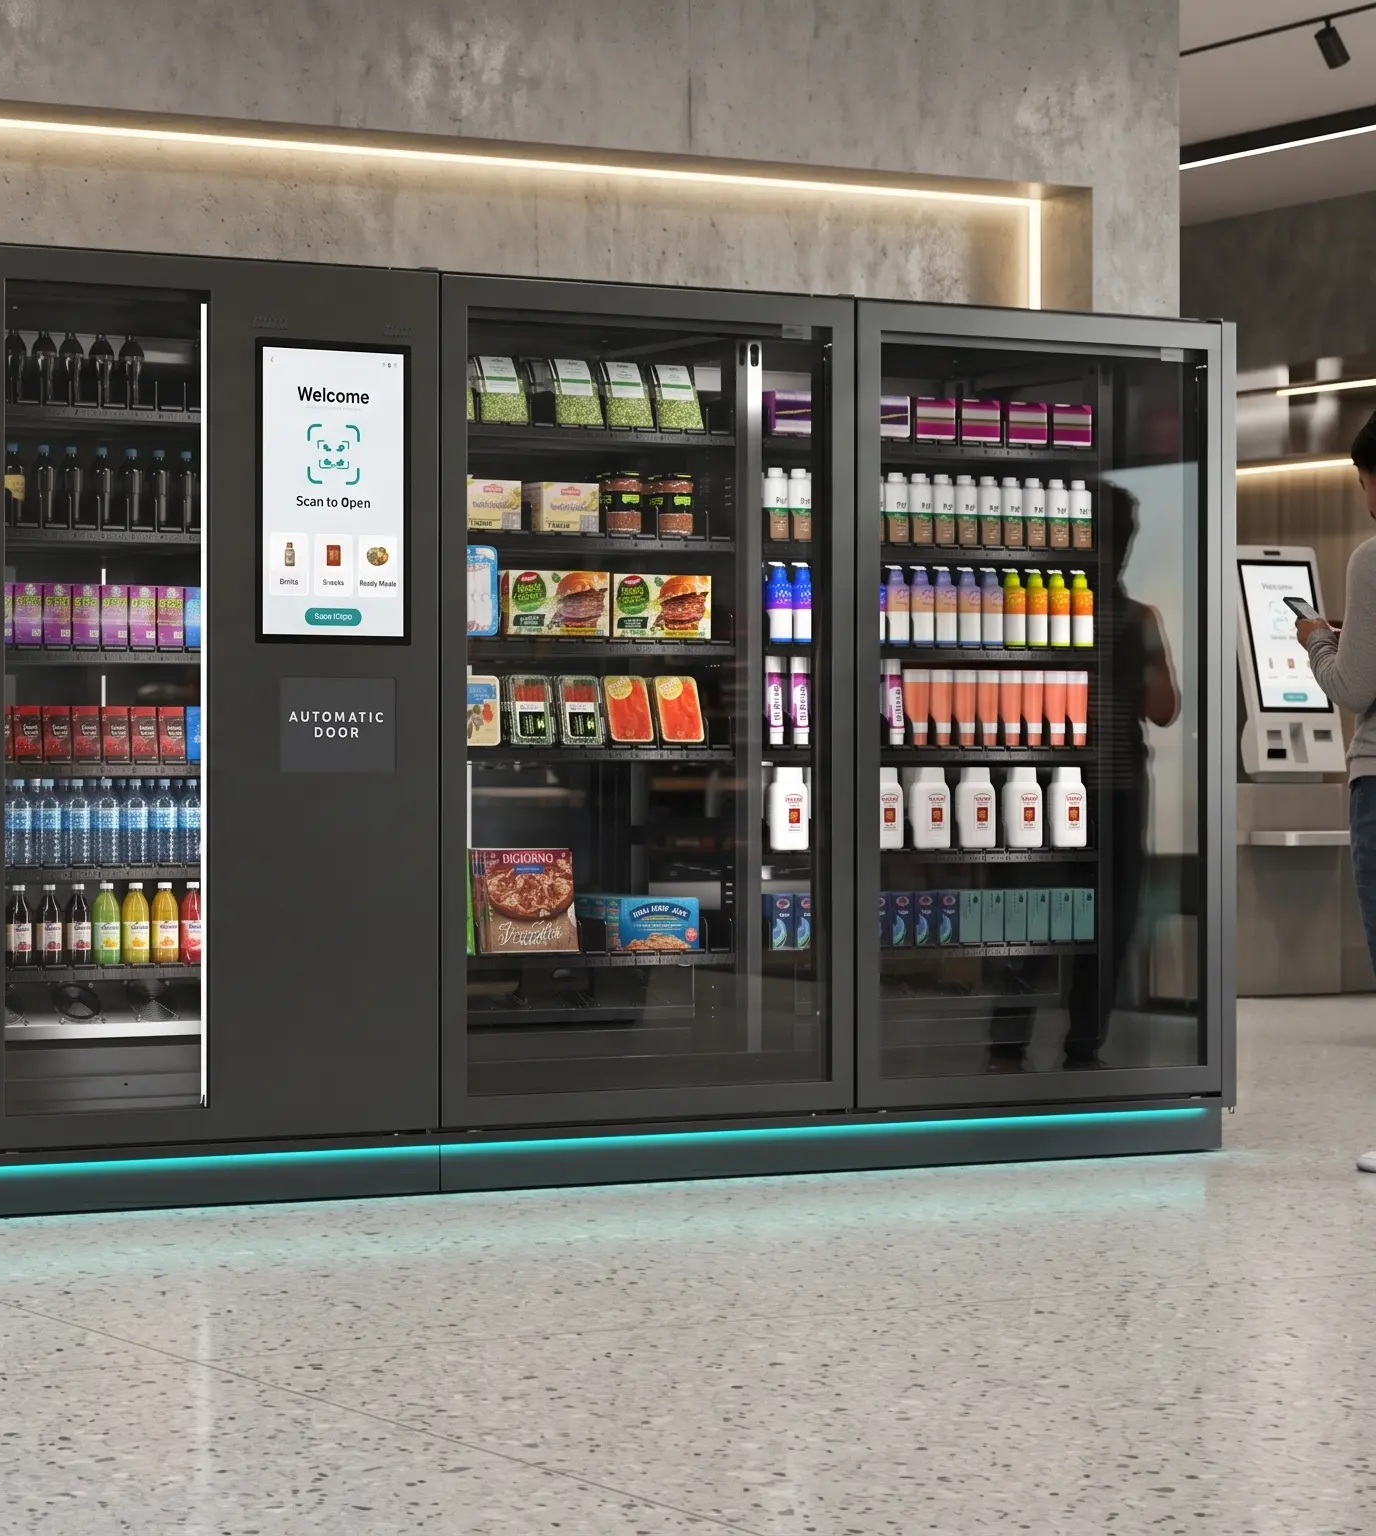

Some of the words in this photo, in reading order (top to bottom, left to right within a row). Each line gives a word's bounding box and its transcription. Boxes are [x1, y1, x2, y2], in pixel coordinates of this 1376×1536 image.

[297, 386, 370, 404] Welcome
[296, 496, 324, 507] Scan
[326, 497, 338, 508] to
[341, 497, 371, 509] Open
[288, 711, 384, 723] AUTOMATIC
[314, 726, 359, 738] DOOR
[502, 853, 554, 864] DIGIORNO
